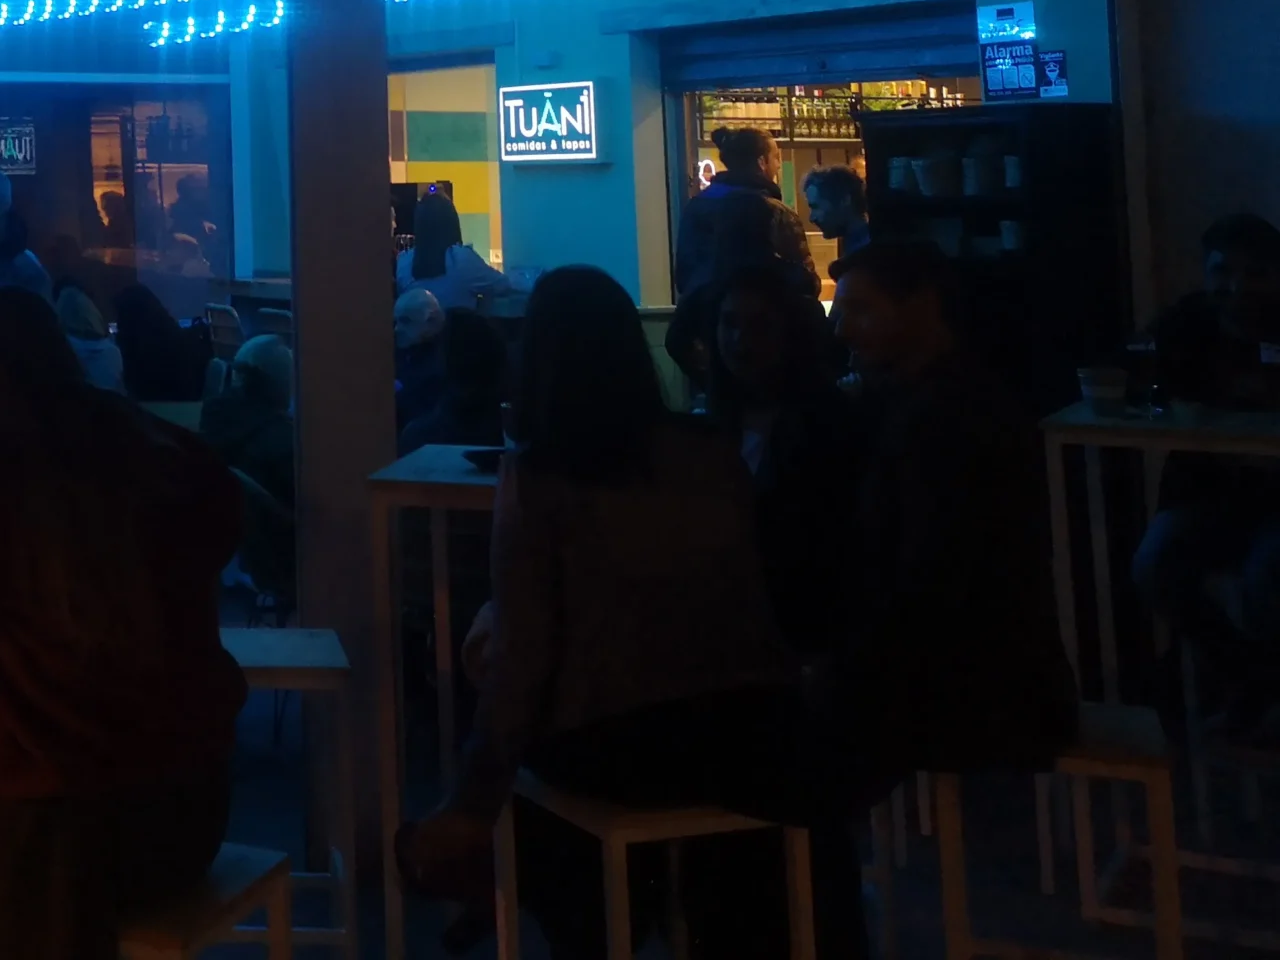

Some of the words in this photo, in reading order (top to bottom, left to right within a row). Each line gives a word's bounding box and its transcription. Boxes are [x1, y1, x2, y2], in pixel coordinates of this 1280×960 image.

[985, 45, 1034, 59] Alarma
[506, 140, 547, 152] comidas
[550, 139, 558, 150] &
[562, 140, 591, 151] tapas
